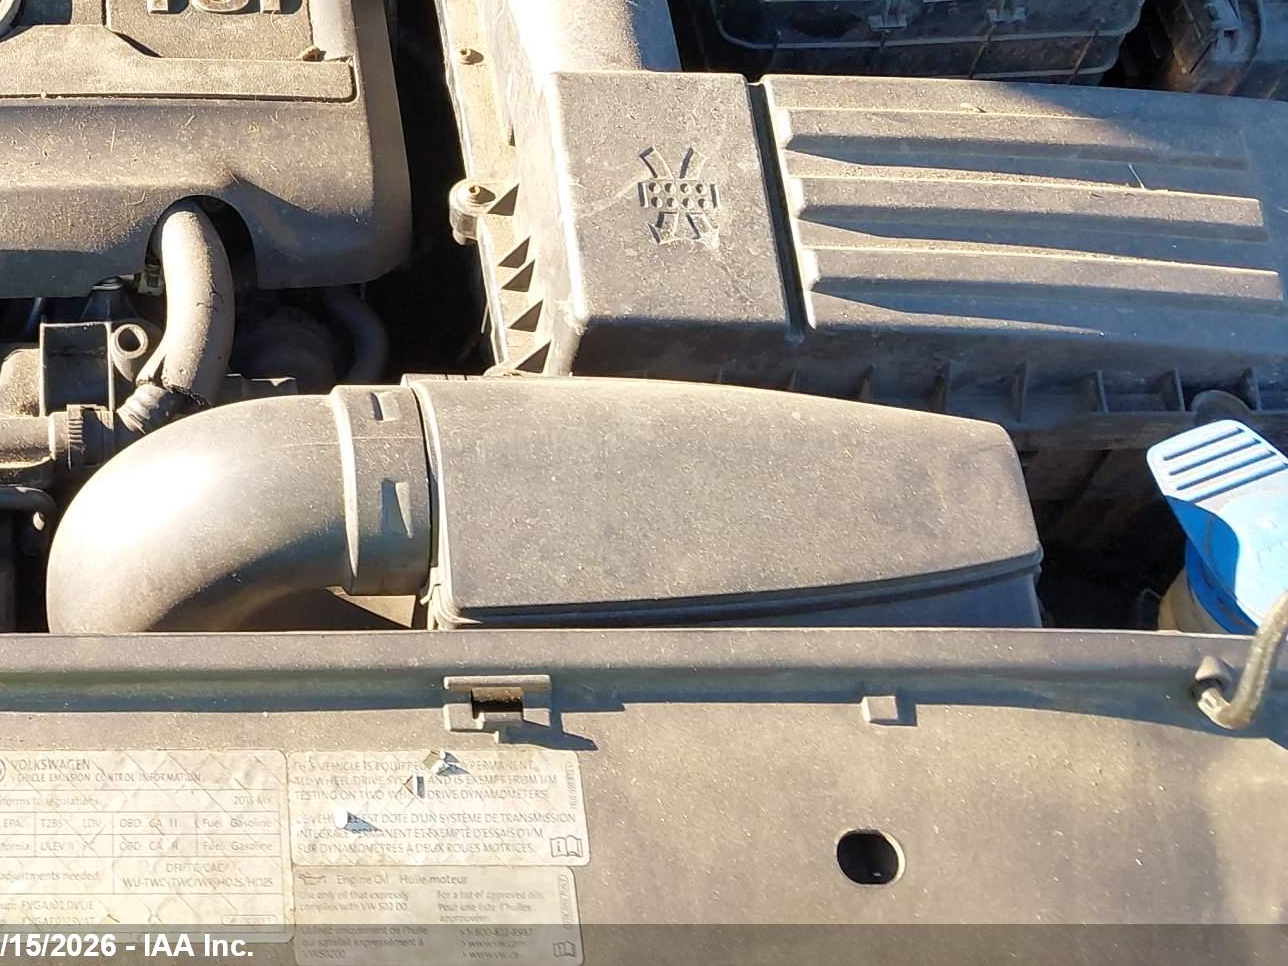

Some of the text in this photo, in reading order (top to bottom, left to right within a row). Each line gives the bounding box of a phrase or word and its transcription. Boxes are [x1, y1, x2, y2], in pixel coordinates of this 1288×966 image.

[10, 758, 90, 771] VOLKSWAGEN
[49, 772, 91, 782] EMISSION
[95, 772, 135, 782] CONTROL
[336, 874, 372, 886] Engine
[400, 874, 426, 884] Huile
[429, 874, 468, 884] moteur
